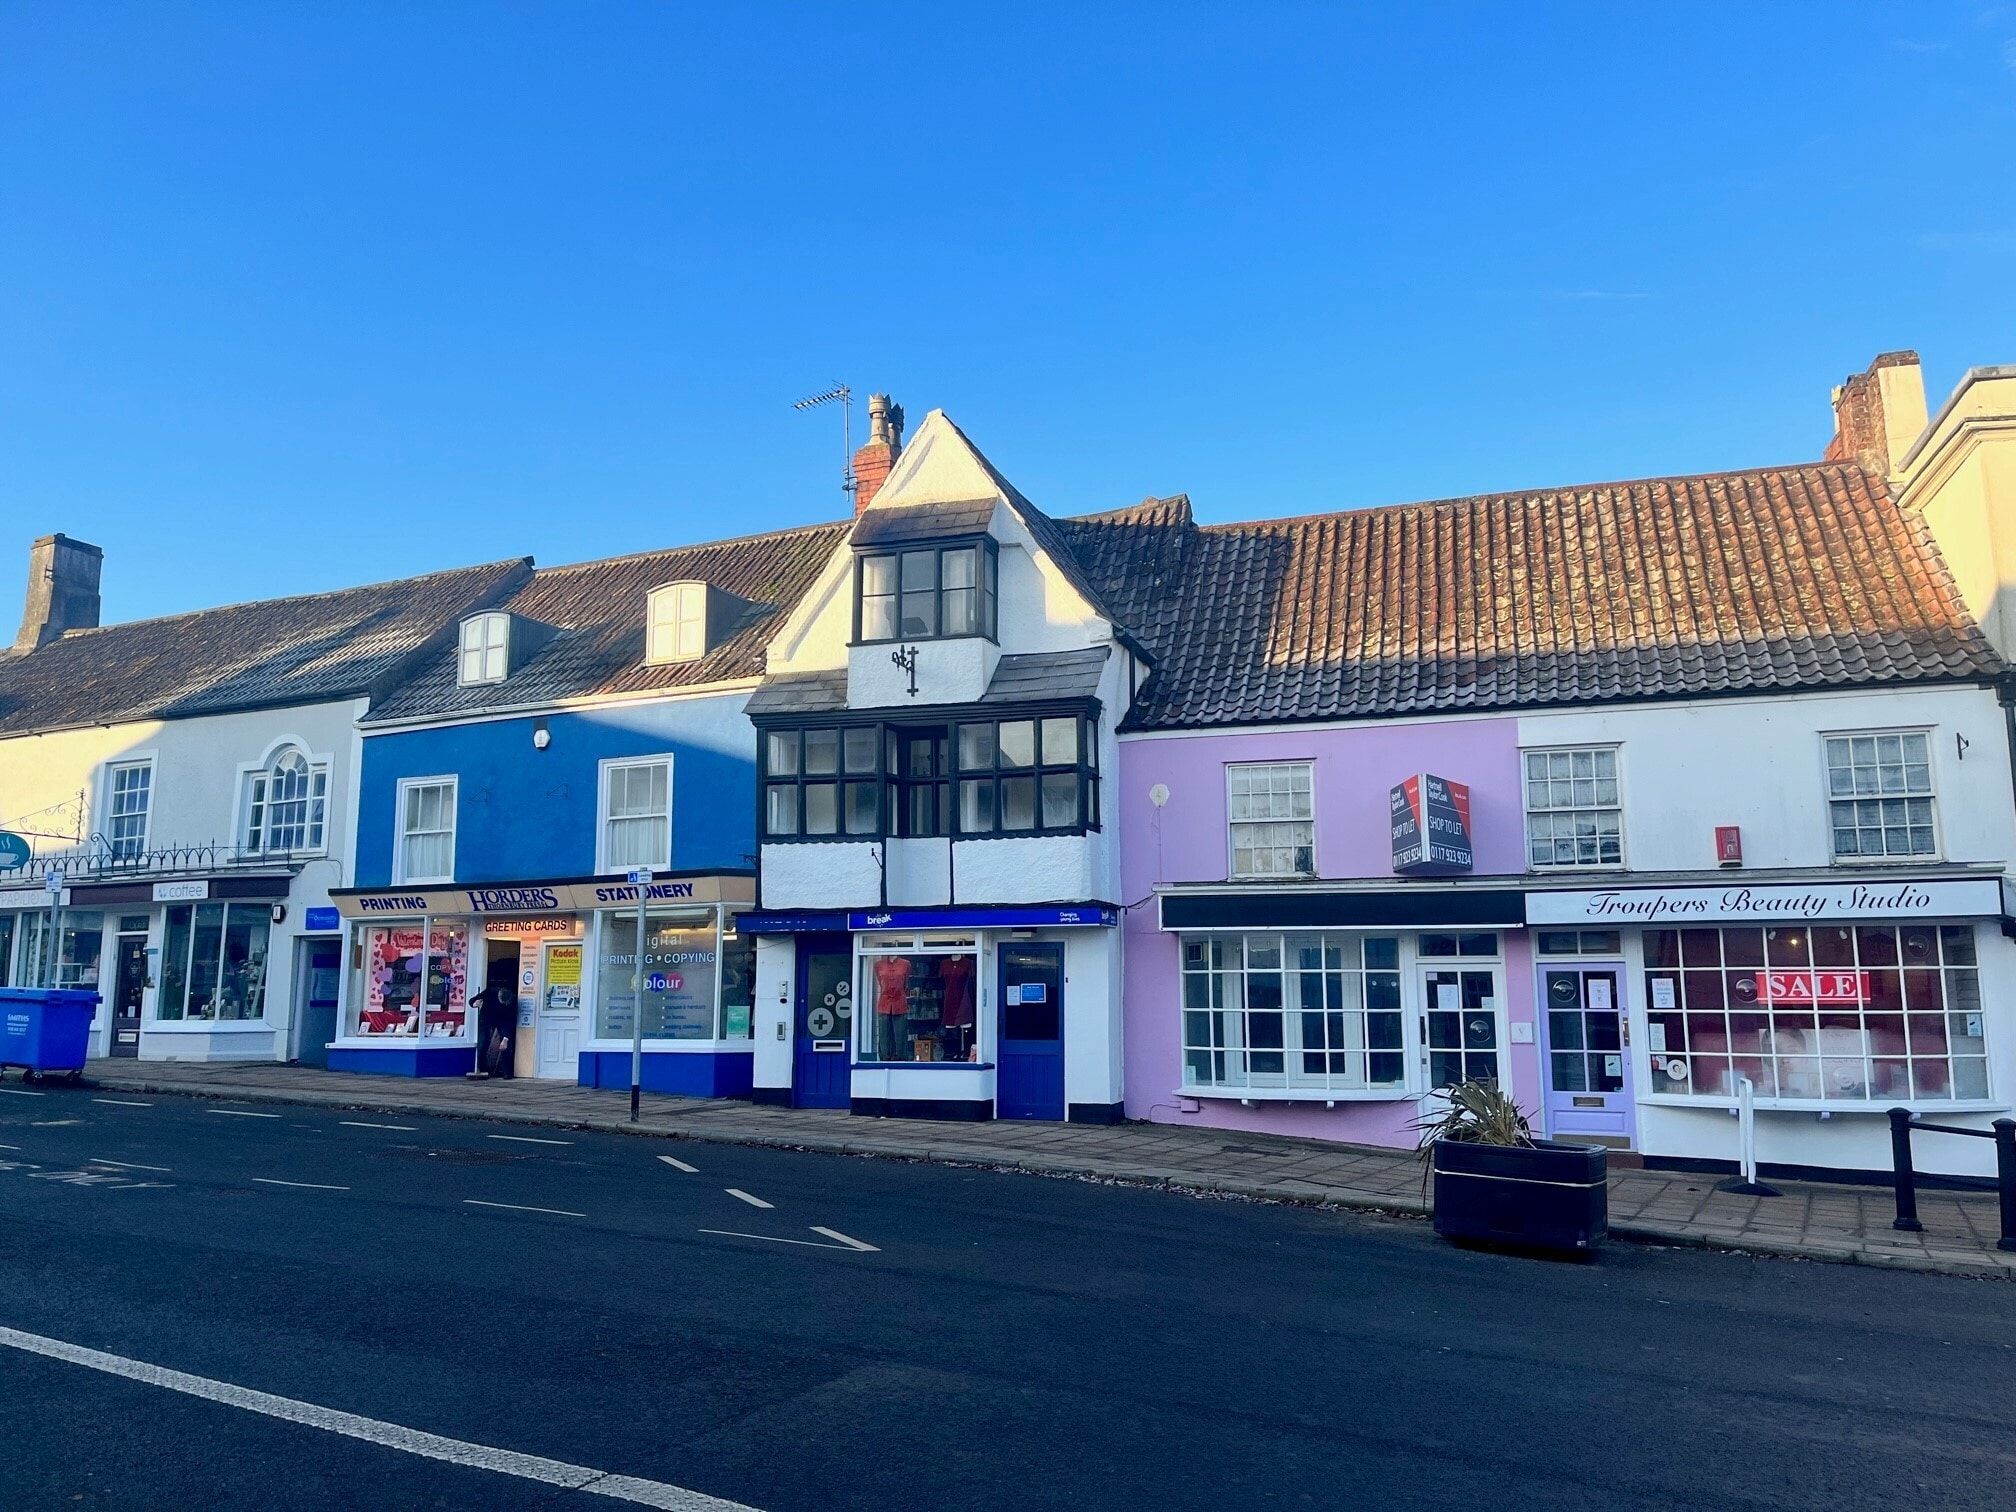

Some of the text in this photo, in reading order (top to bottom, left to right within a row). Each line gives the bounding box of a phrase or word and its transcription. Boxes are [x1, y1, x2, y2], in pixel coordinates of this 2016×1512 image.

[1392, 824, 1402, 840] SHOP
[1429, 816, 1463, 836] SHOP TO LET
[1430, 845, 1472, 866] 0117 923 9234
[169, 884, 203, 898] coffee
[359, 896, 427, 911] PRINTING
[466, 888, 559, 912] HORDERS
[1586, 885, 1931, 921] Troupers Beauty Studio
[867, 913, 892, 924] break
[485, 920, 567, 933] GREETING CARDS
[646, 934, 682, 949] igital
[552, 948, 579, 958] Kodak
[602, 952, 715, 965] PRINTIG COPYING
[634, 976, 681, 990] olour
[1769, 975, 1857, 998] SALE
